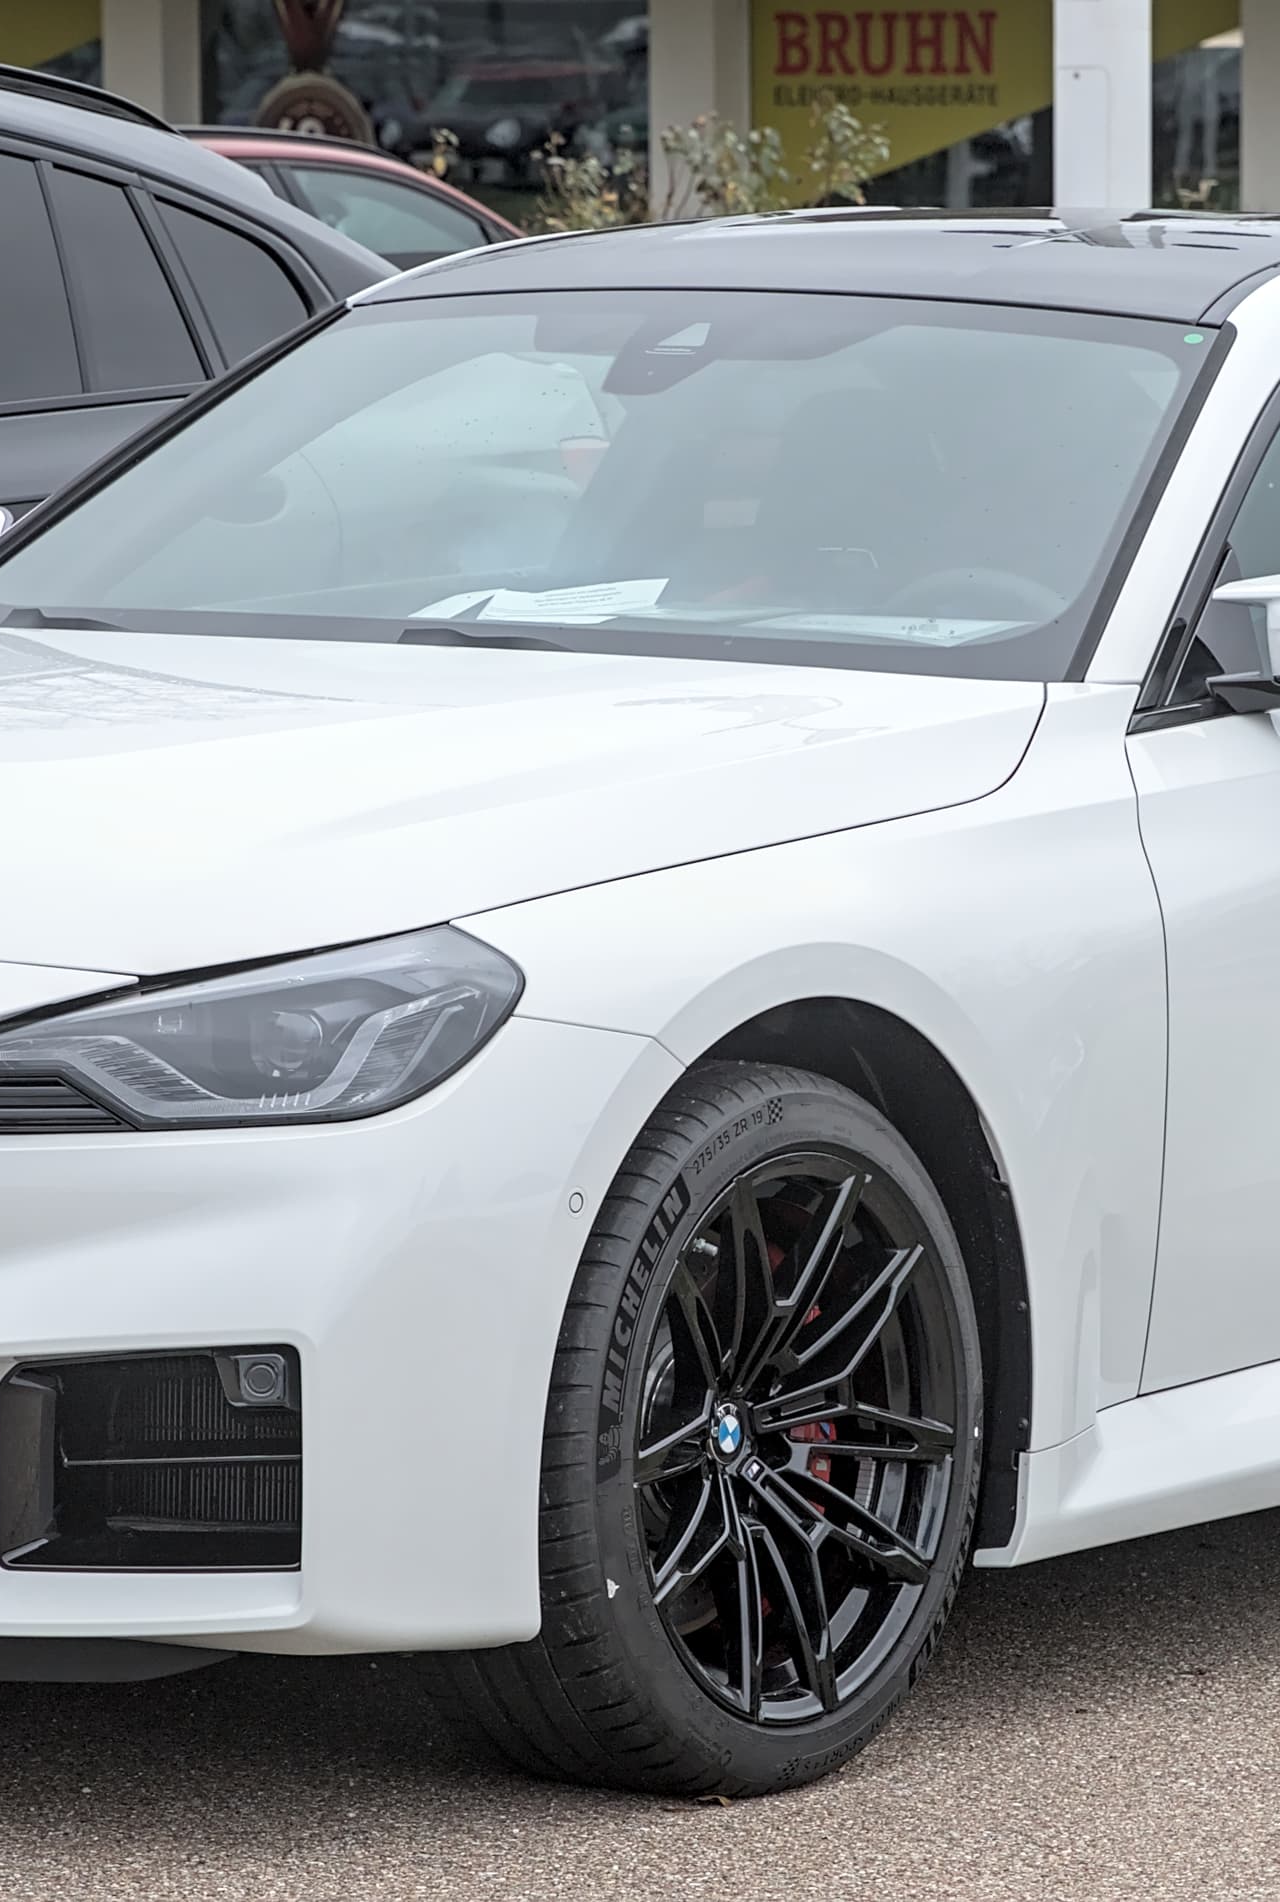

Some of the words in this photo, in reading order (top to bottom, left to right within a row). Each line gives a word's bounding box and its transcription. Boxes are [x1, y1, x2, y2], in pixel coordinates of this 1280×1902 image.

[773, 9, 998, 77] BRUHN
[692, 1130, 730, 1176] 275/35
[732, 1118, 750, 1137] ZR
[751, 1110, 764, 1126] 19
[601, 1186, 684, 1415] MICHELIN
